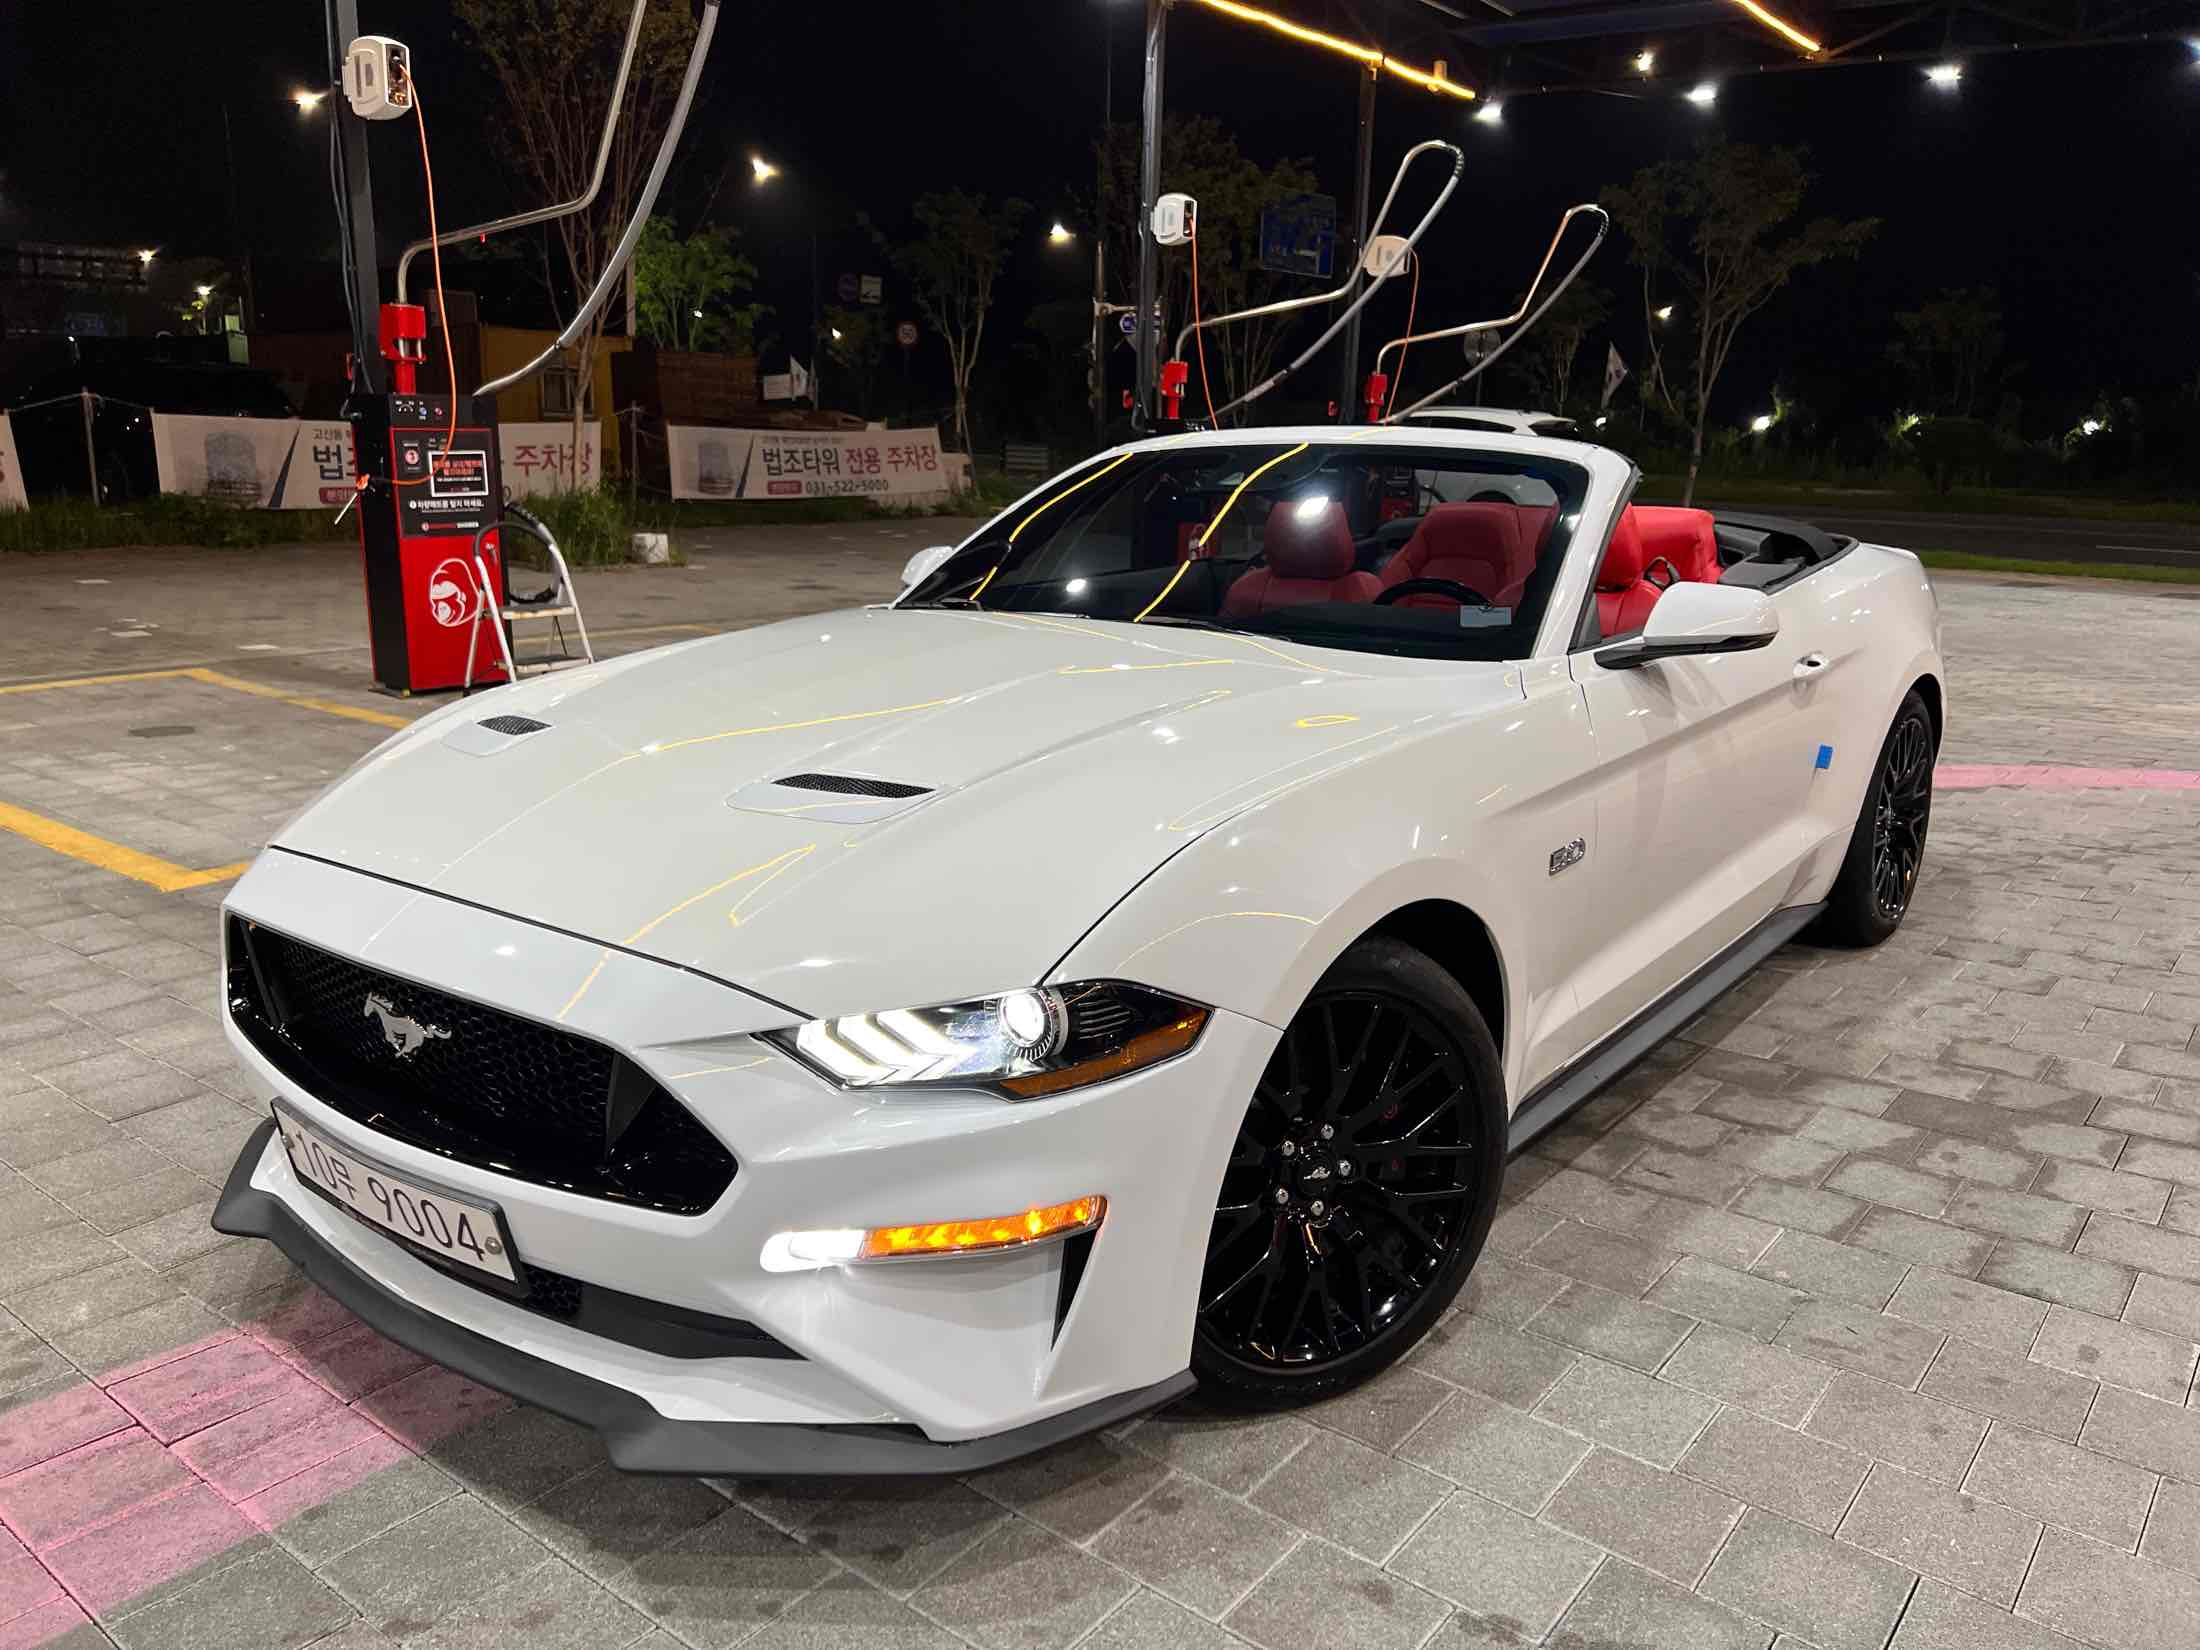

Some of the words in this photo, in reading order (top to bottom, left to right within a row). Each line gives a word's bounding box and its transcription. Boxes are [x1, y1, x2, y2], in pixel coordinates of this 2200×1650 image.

[762, 448, 840, 476] 법조타워
[845, 447, 881, 474] 전용
[887, 445, 938, 473] 주차장
[367, 1176, 487, 1263] 9004
